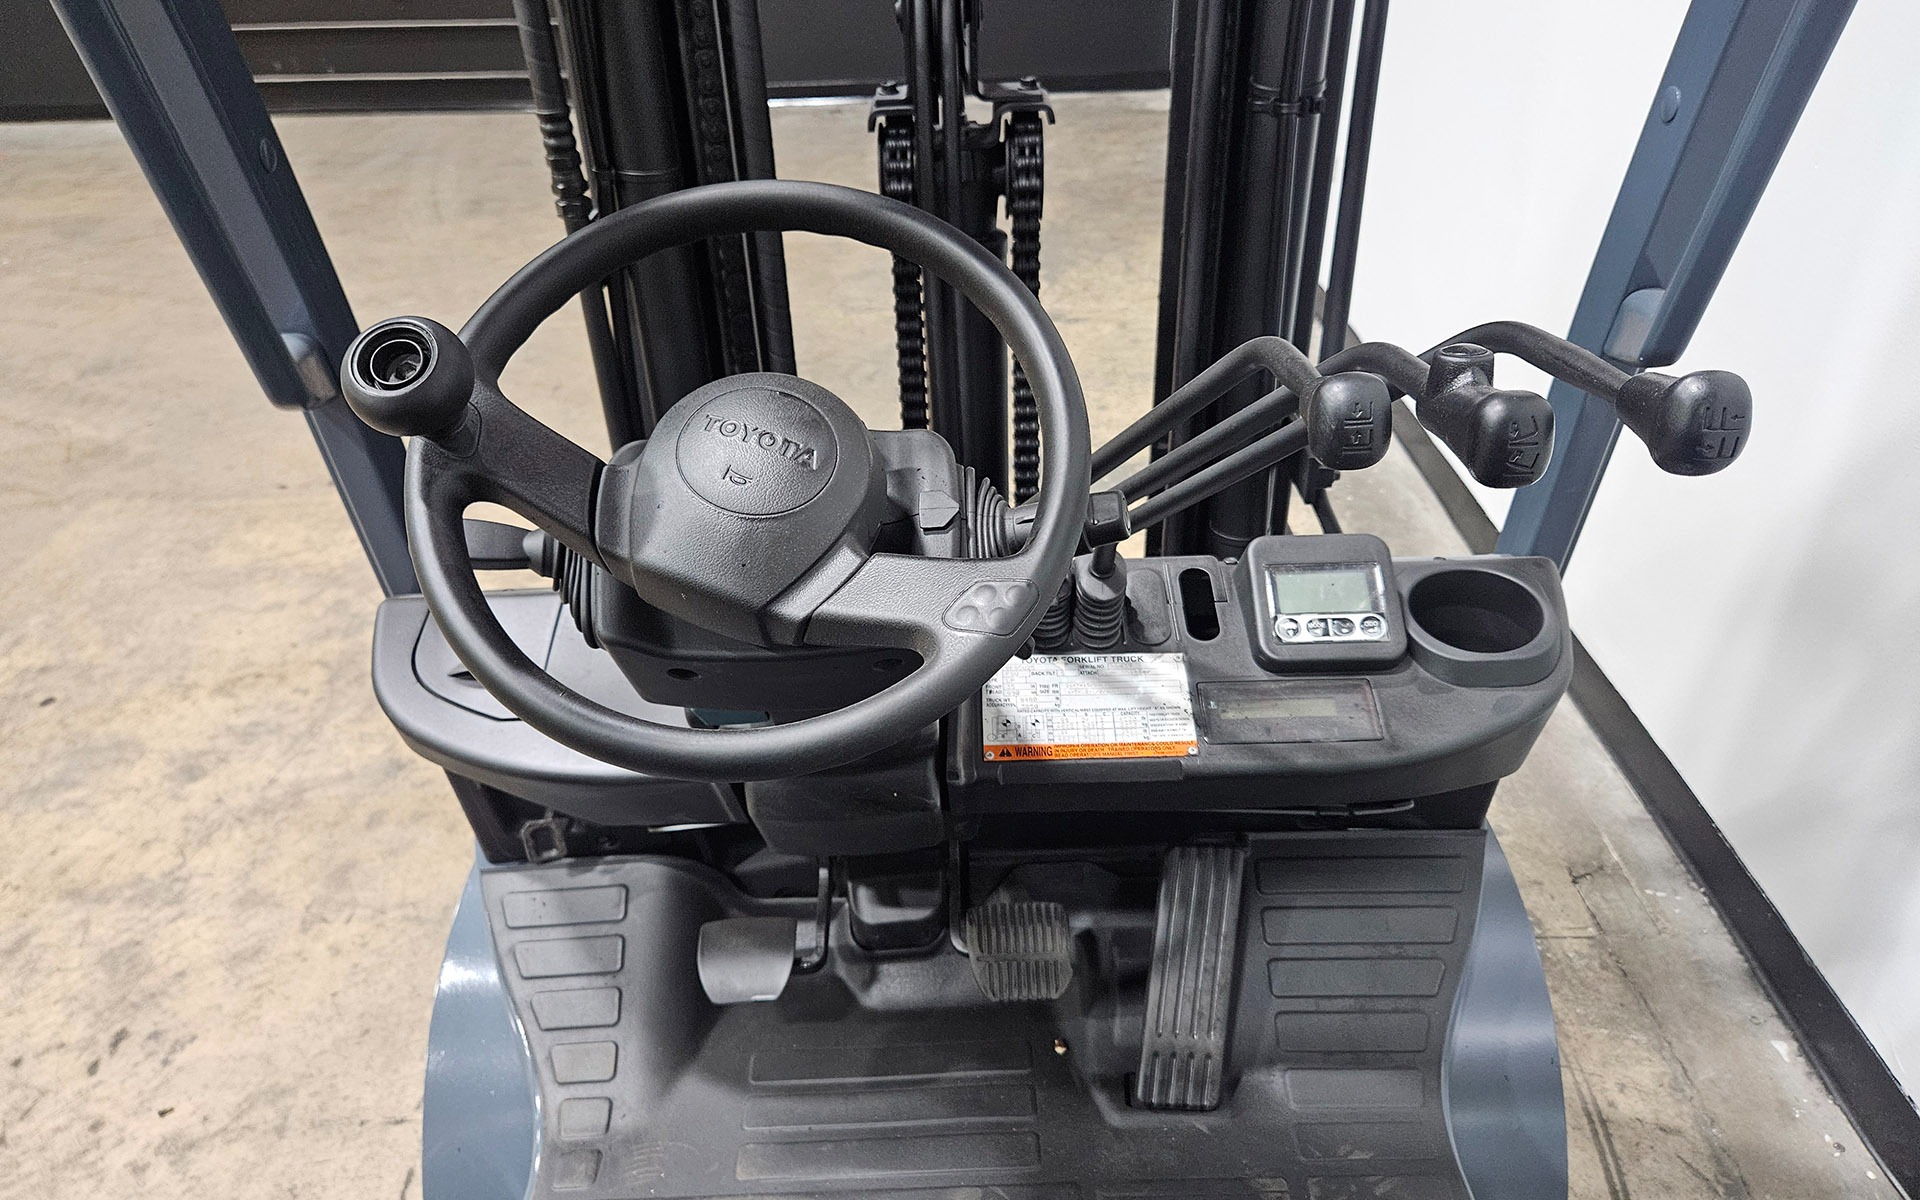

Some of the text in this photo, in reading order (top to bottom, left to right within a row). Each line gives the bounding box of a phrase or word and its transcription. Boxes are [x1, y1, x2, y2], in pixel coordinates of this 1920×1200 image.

[702, 414, 818, 471] TOYOTA
[1061, 655, 1108, 663] FORKLIFT
[1112, 655, 1144, 663] TRUCK
[1014, 746, 1053, 757] WARNING
